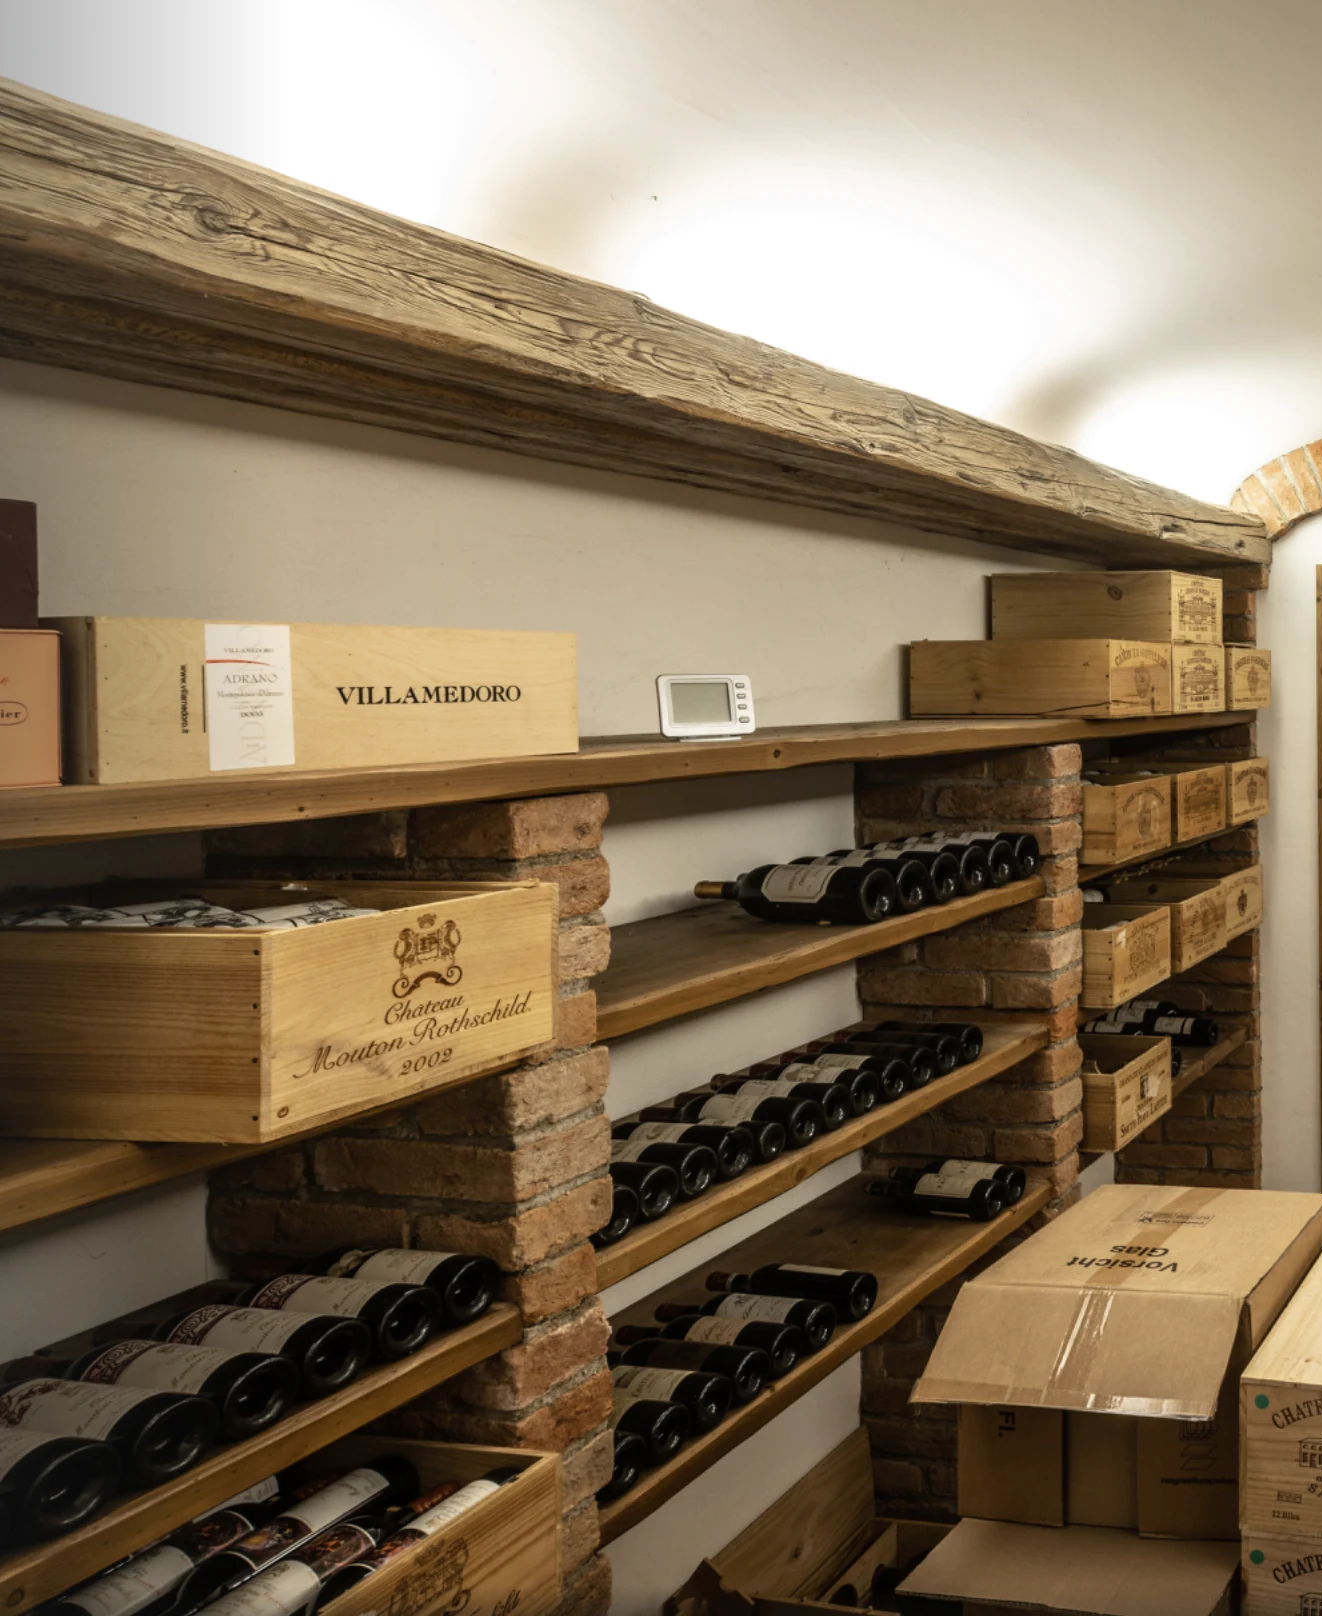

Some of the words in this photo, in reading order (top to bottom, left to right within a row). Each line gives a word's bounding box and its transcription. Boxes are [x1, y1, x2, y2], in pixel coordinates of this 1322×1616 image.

[222, 673, 279, 685] ADRANO
[179, 664, 190, 734] www.villamedoro.it
[335, 684, 522, 705] VILLAMEDORO
[292, 1036, 406, 1079] Mouton
[408, 989, 533, 1046] Rothschild
[397, 1047, 453, 1078] 2002
[1110, 1245, 1169, 1257] Glas
[1066, 1256, 1178, 1273] Vorsicht
[1271, 1509, 1281, 1519] 12
